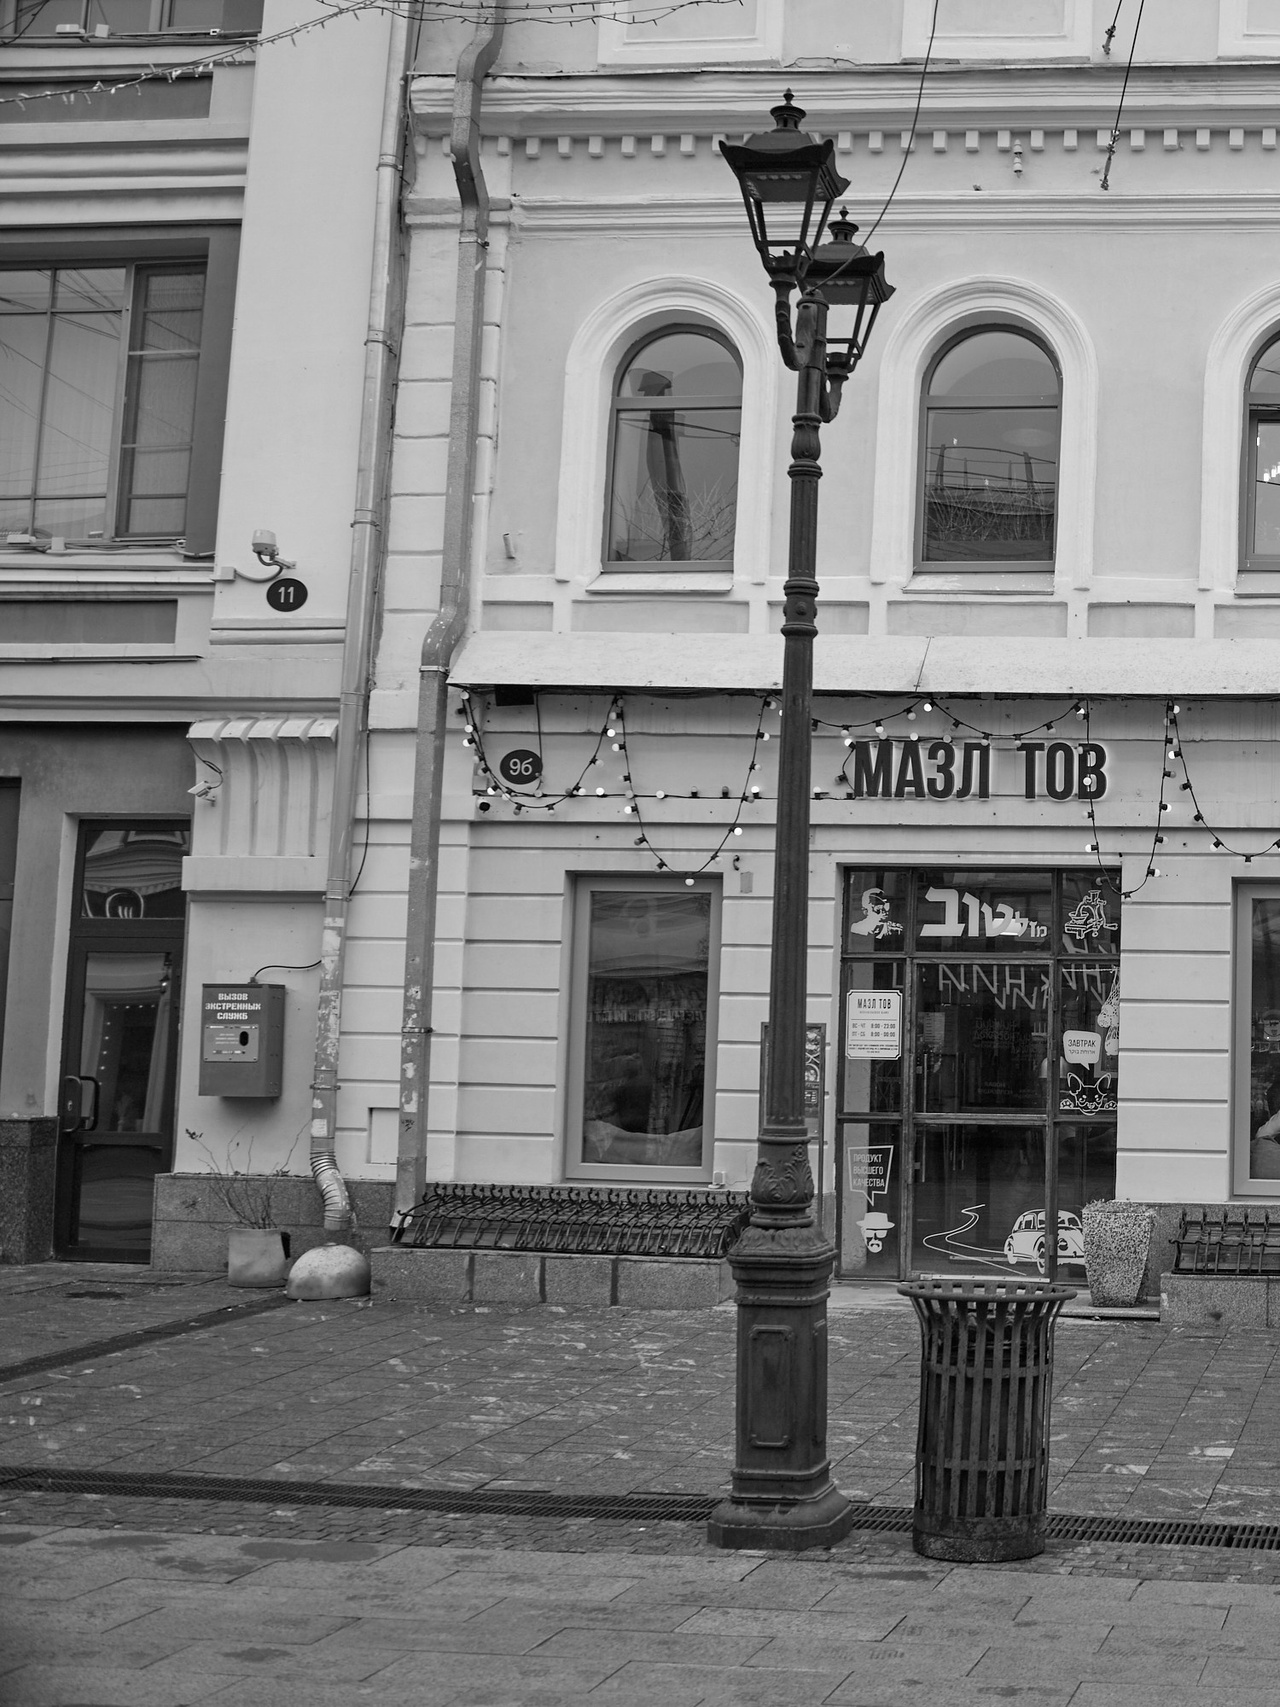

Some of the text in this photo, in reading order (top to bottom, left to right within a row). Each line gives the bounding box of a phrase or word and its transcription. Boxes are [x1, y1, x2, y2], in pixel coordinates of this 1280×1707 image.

[278, 586, 295, 603] 11
[854, 741, 1107, 800] МАЗЛ ТОВ
[218, 993, 248, 1001] ВЫЗОВ
[857, 998, 892, 1009] МАЗЛ ТОВ
[217, 1012, 248, 1020] СЛУЖБ
[1068, 1039, 1096, 1048] ЗАВТРАК
[853, 1154, 882, 1163] ПРОДУКТ
[853, 1166, 884, 1175] ВЫСШЕГО
[853, 1178, 885, 1187] КАЧЕСТВА
